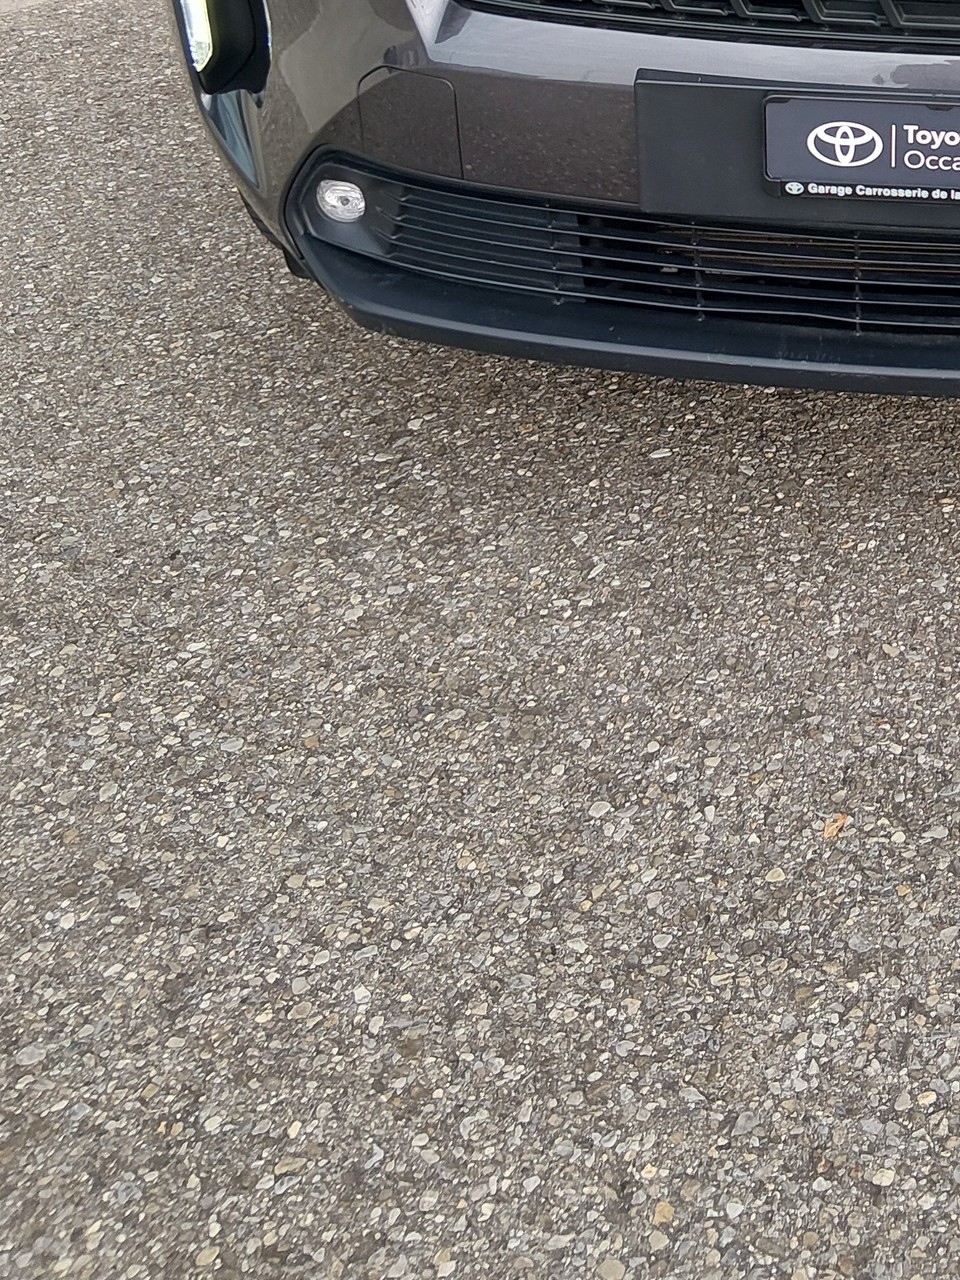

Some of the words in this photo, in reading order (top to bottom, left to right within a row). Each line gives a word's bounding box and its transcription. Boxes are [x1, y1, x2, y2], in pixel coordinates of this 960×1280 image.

[807, 183, 853, 197] Garage
[855, 185, 930, 199] Carrosserie
[931, 189, 948, 200] de
